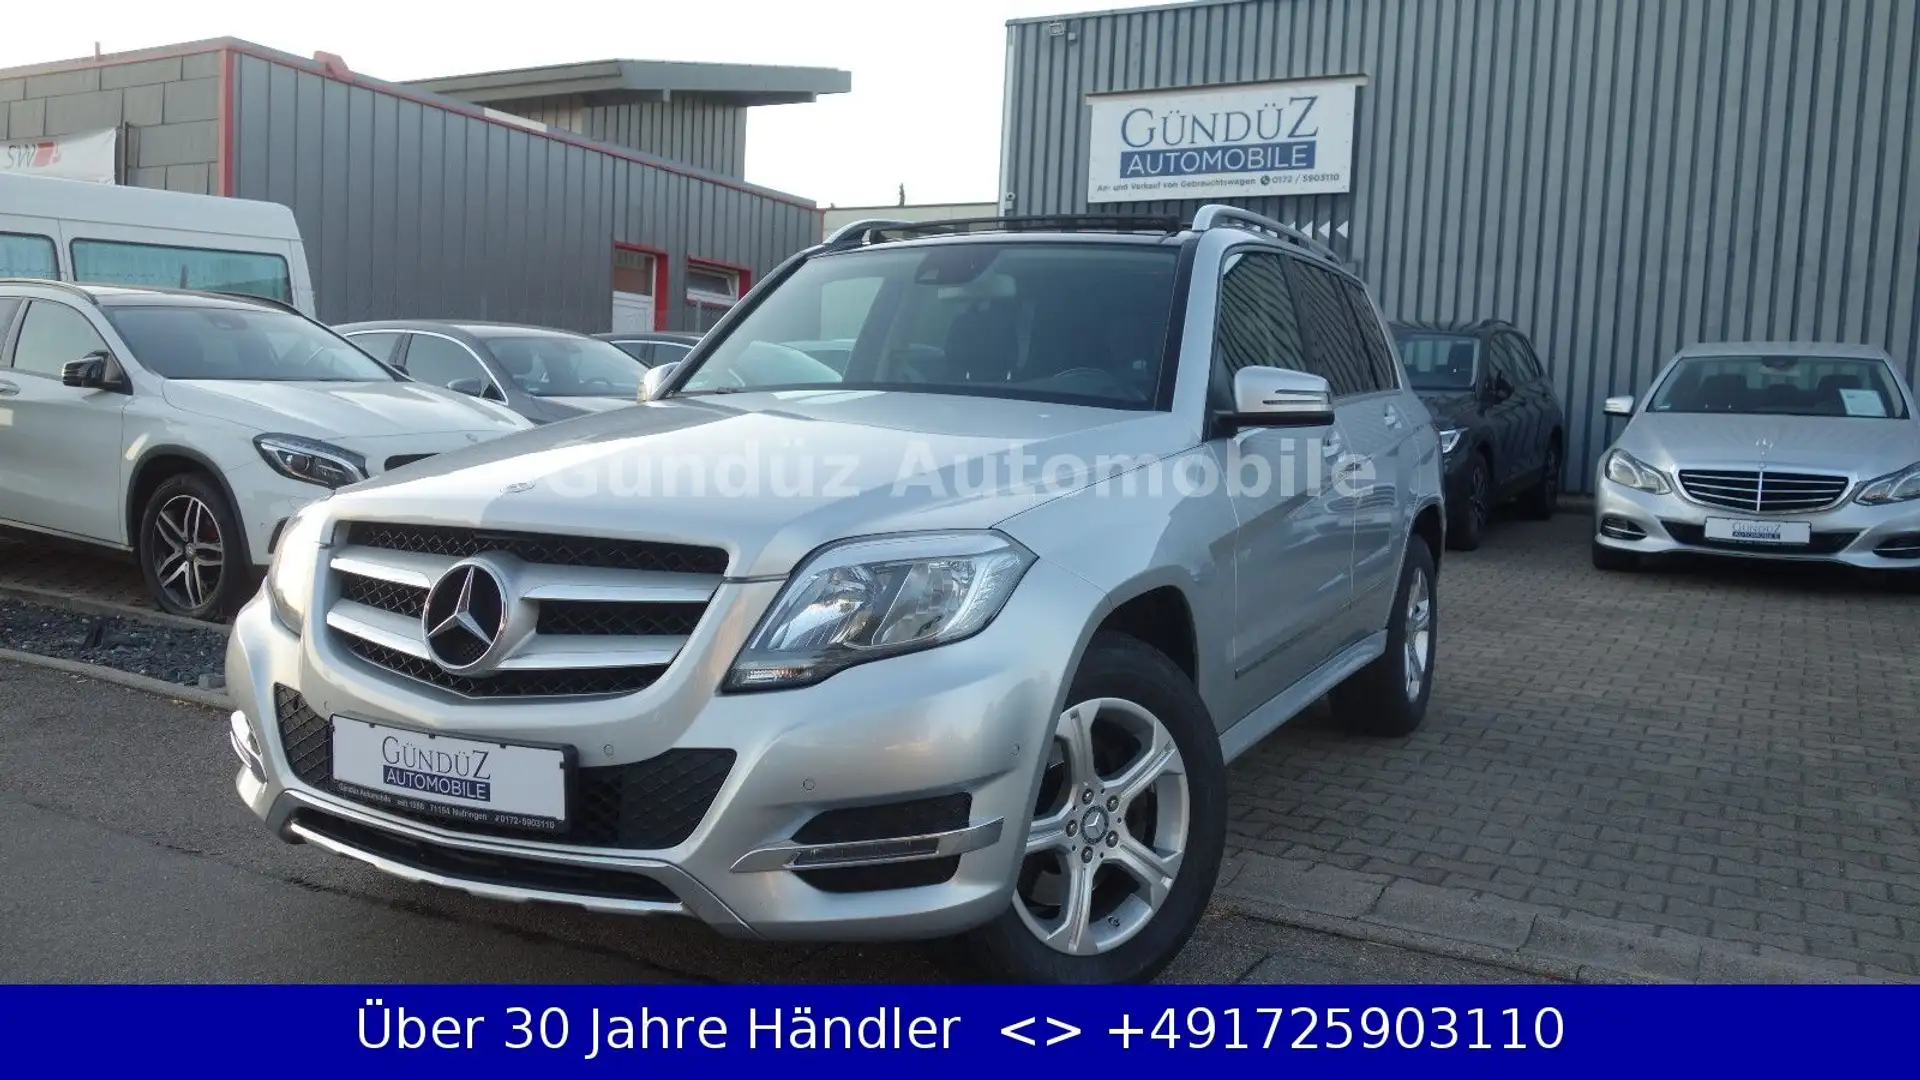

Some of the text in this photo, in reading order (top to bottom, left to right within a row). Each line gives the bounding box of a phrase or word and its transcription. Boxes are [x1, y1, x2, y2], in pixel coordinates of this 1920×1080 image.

[1121, 95, 1319, 148] GÜNDÜZ
[1126, 145, 1309, 175] AUTOMOBILE
[1113, 182, 1128, 191] und
[1131, 181, 1160, 190] Verkauf
[382, 735, 491, 780] GÜNDÜZ
[386, 769, 487, 800] AUTOMOBILE
